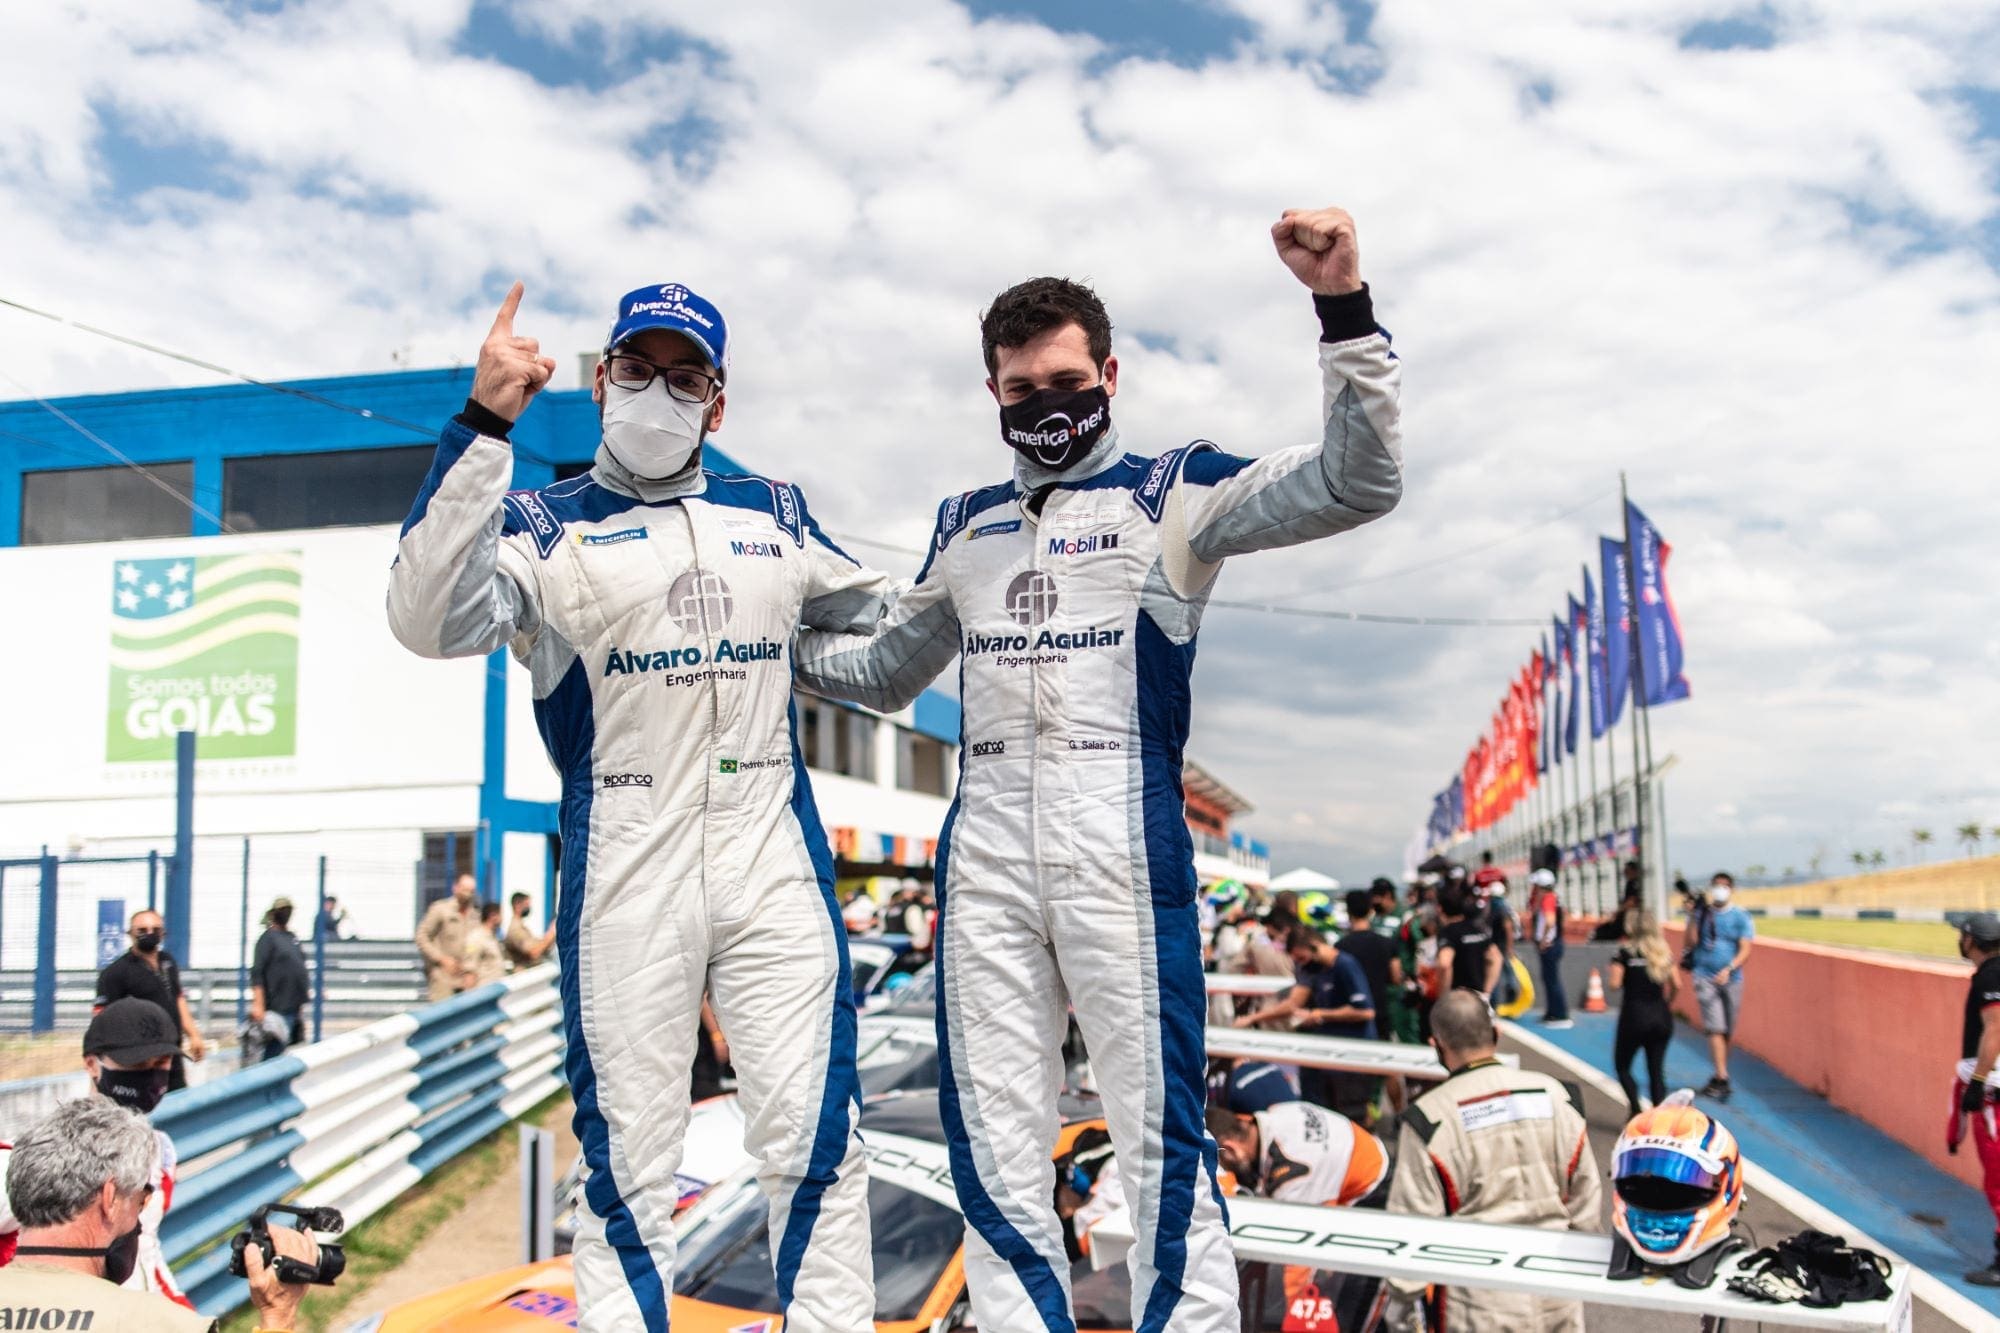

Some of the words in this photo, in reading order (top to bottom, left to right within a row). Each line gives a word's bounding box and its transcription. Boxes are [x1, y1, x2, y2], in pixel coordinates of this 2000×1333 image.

[595, 531, 641, 544] MICHELIN
[1049, 535, 1098, 555] Mobil
[730, 541, 769, 557] Mobil
[966, 631, 1028, 658] Álvaro
[1033, 625, 1125, 651] Aguiar
[604, 646, 702, 677] Álvaro
[714, 636, 783, 664] Aguiar
[996, 652, 1069, 669] Engenharia
[126, 673, 206, 700] Somos
[210, 668, 278, 697] todos
[665, 667, 747, 688] Engenharia
[1081, 740, 1106, 751] Salas
[603, 772, 653, 788] sparco
[1230, 1224, 1609, 1278] ORSC
[0, 1306, 95, 1332] anon
